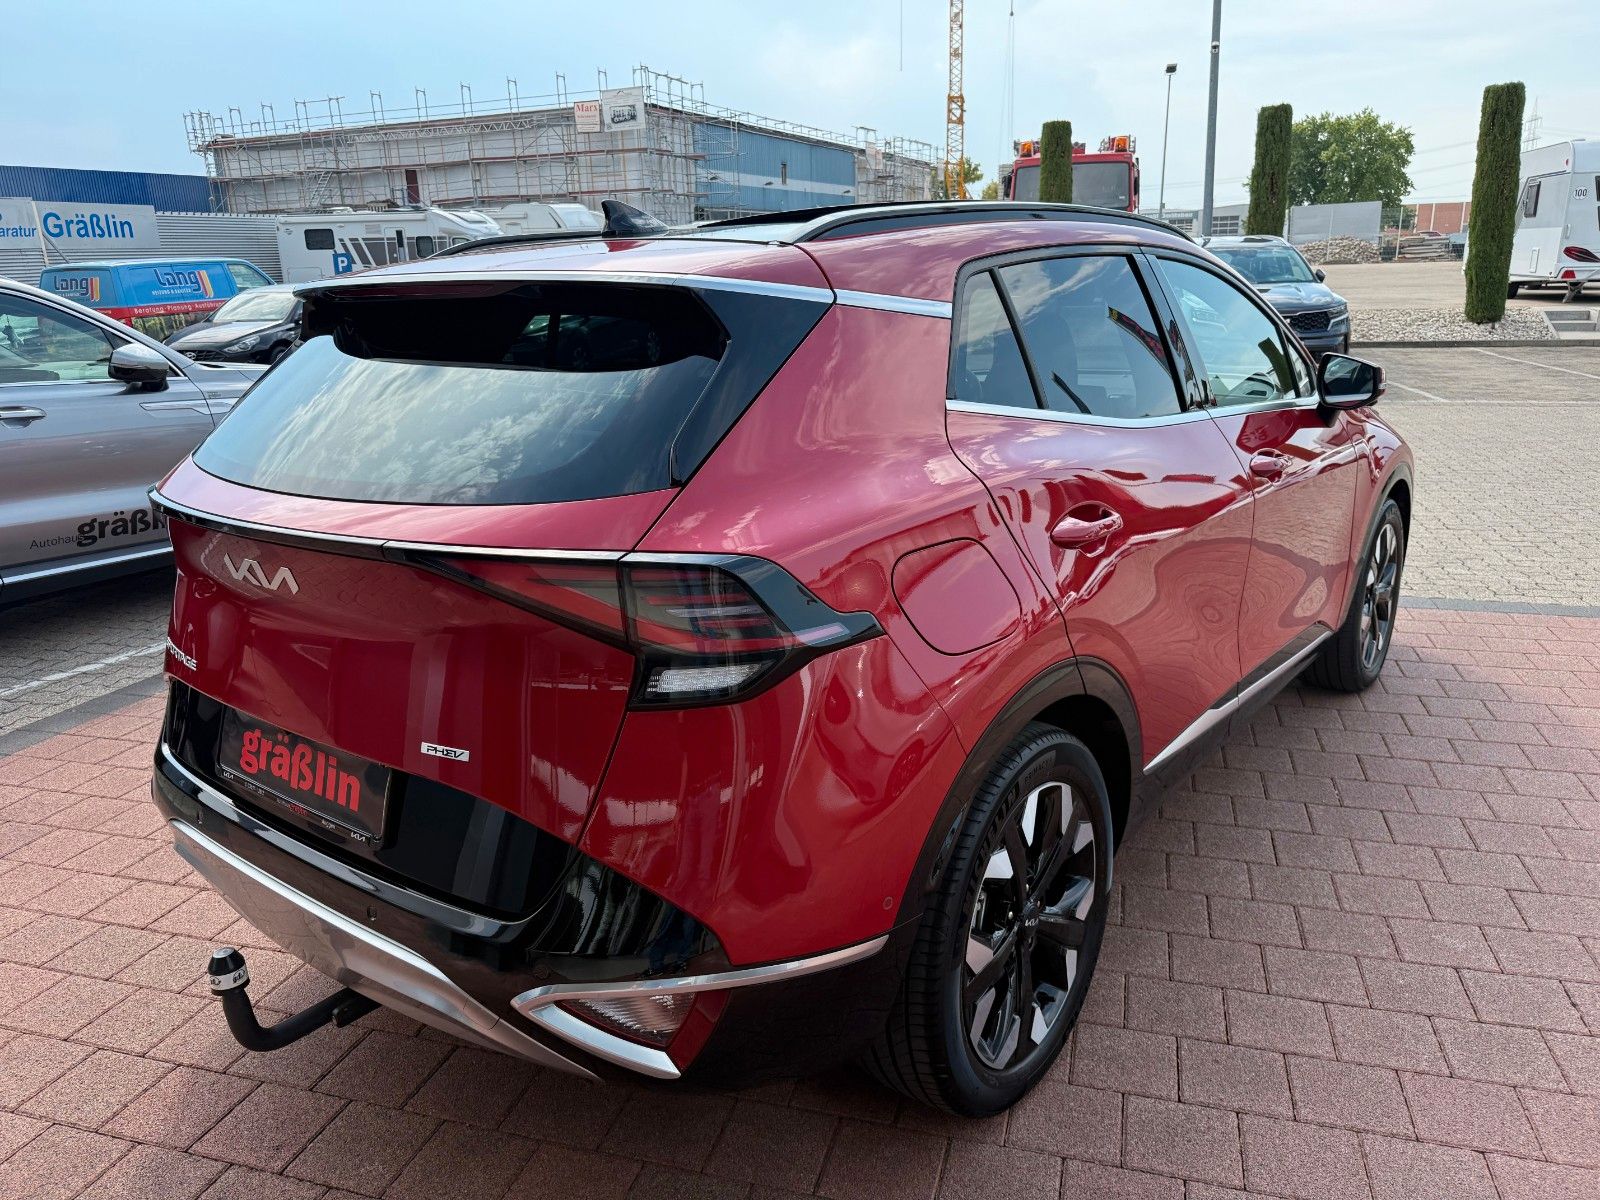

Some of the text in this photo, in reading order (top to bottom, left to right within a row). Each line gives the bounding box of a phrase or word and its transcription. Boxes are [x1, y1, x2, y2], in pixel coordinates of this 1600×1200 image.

[1574, 188, 1588, 197] 100
[42, 211, 135, 239] Gräßlin
[338, 257, 348, 272] P
[223, 552, 300, 595] KIA
[426, 744, 465, 759] PHEV
[239, 728, 362, 813] gräßlin
